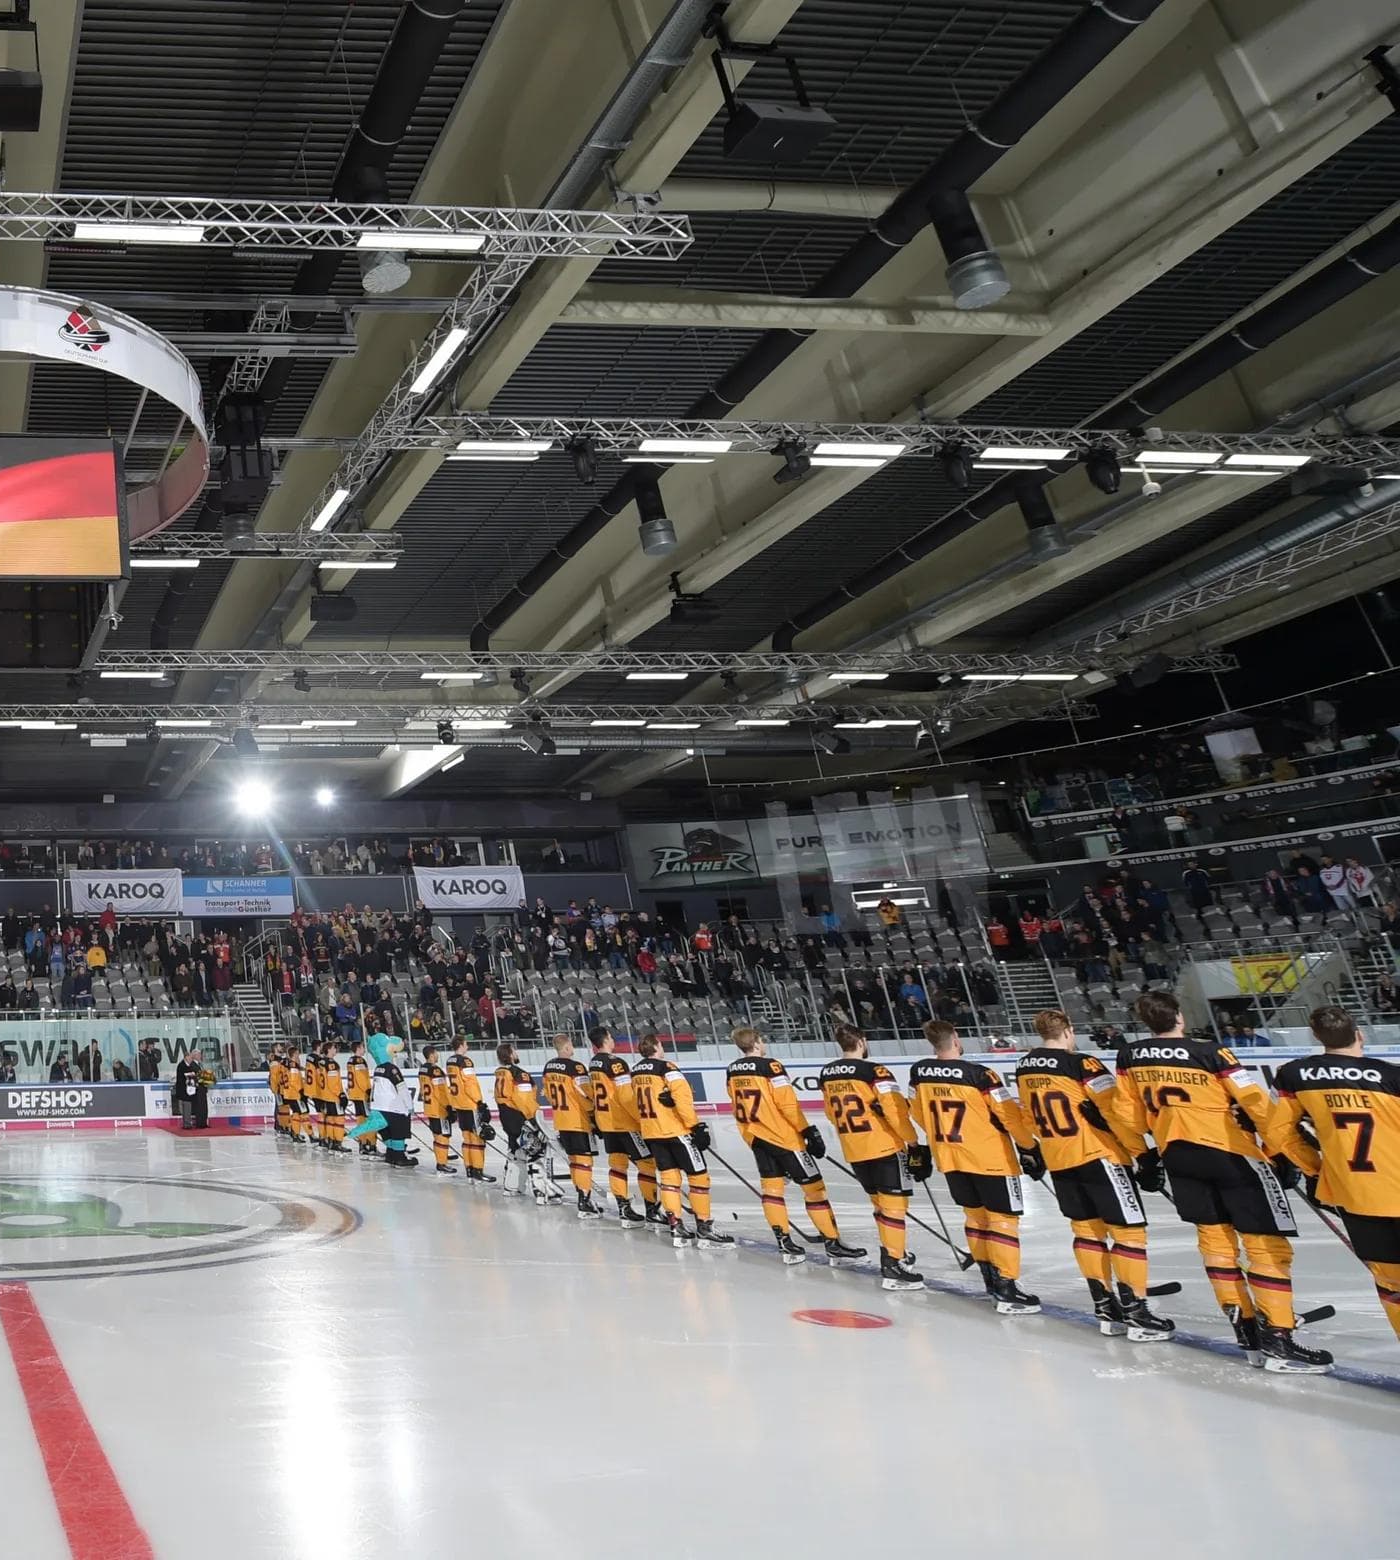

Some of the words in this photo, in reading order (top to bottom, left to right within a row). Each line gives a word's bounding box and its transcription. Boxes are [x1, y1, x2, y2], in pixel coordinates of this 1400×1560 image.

[848, 821, 962, 844] EMOTION
[87, 882, 165, 900] KAROQ
[224, 879, 267, 888] SCHANNER
[432, 878, 507, 896] KAROQ
[1130, 1046, 1190, 1061] KAROQ
[1016, 1057, 1058, 1069] KAROQ
[917, 1066, 963, 1079] KAROQ
[1300, 1066, 1383, 1083] KAROQ
[549, 1083, 570, 1111] 91
[636, 1086, 658, 1119] 41
[1324, 1094, 1373, 1109] BOYLE
[16, 1108, 86, 1116] WWW.DEF-SHOP.COM
[734, 1089, 762, 1124] 67
[830, 1094, 872, 1134] 22
[1031, 1090, 1080, 1139] 40
[929, 1100, 967, 1144] 17
[1332, 1112, 1377, 1173] 7
